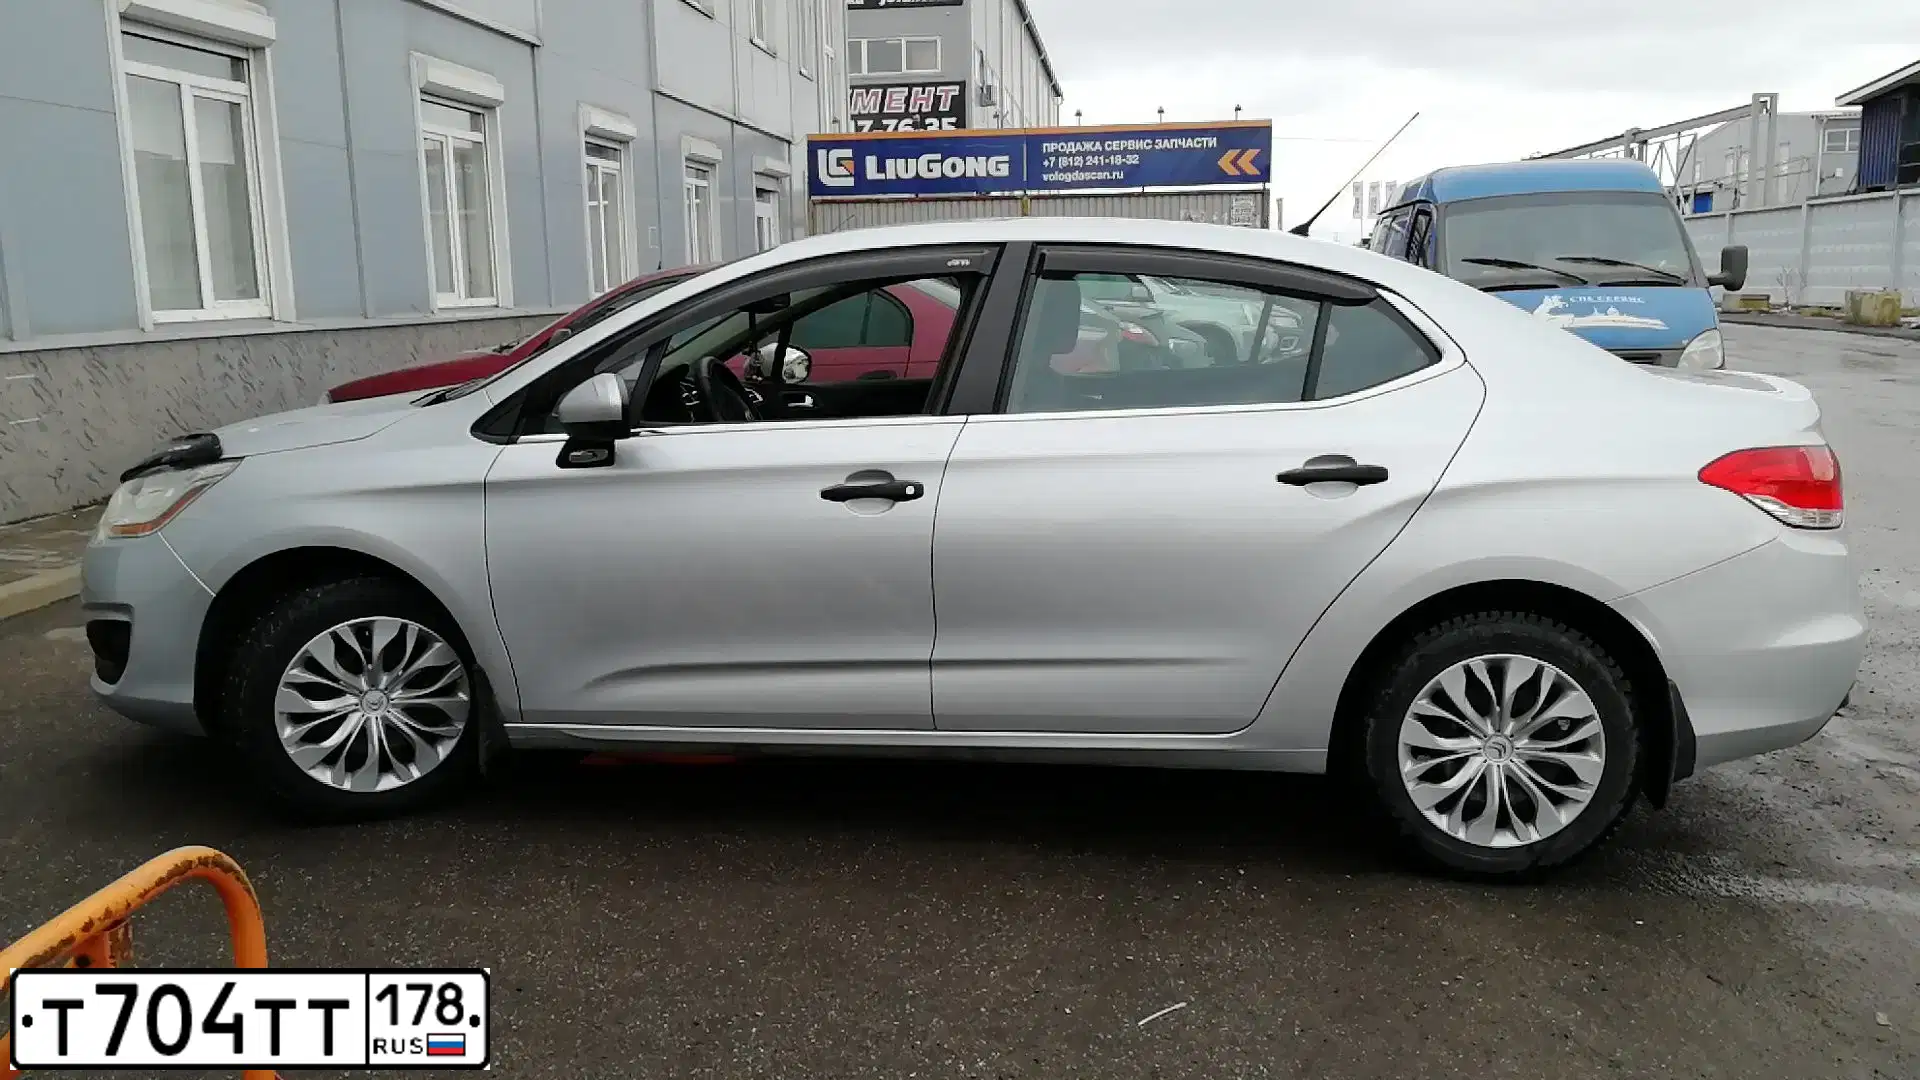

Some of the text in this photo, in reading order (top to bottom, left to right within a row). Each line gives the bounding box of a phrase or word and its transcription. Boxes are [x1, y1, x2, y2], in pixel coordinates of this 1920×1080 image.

[850, 85, 959, 115] МЕНТ
[1042, 137, 1217, 154] ПРОДАЖА СЕРВИС ЗАПЧАСТИ
[1042, 154, 1140, 168] +7 (812) 241-18-32
[1042, 170, 1124, 183] vologdascan.ru
